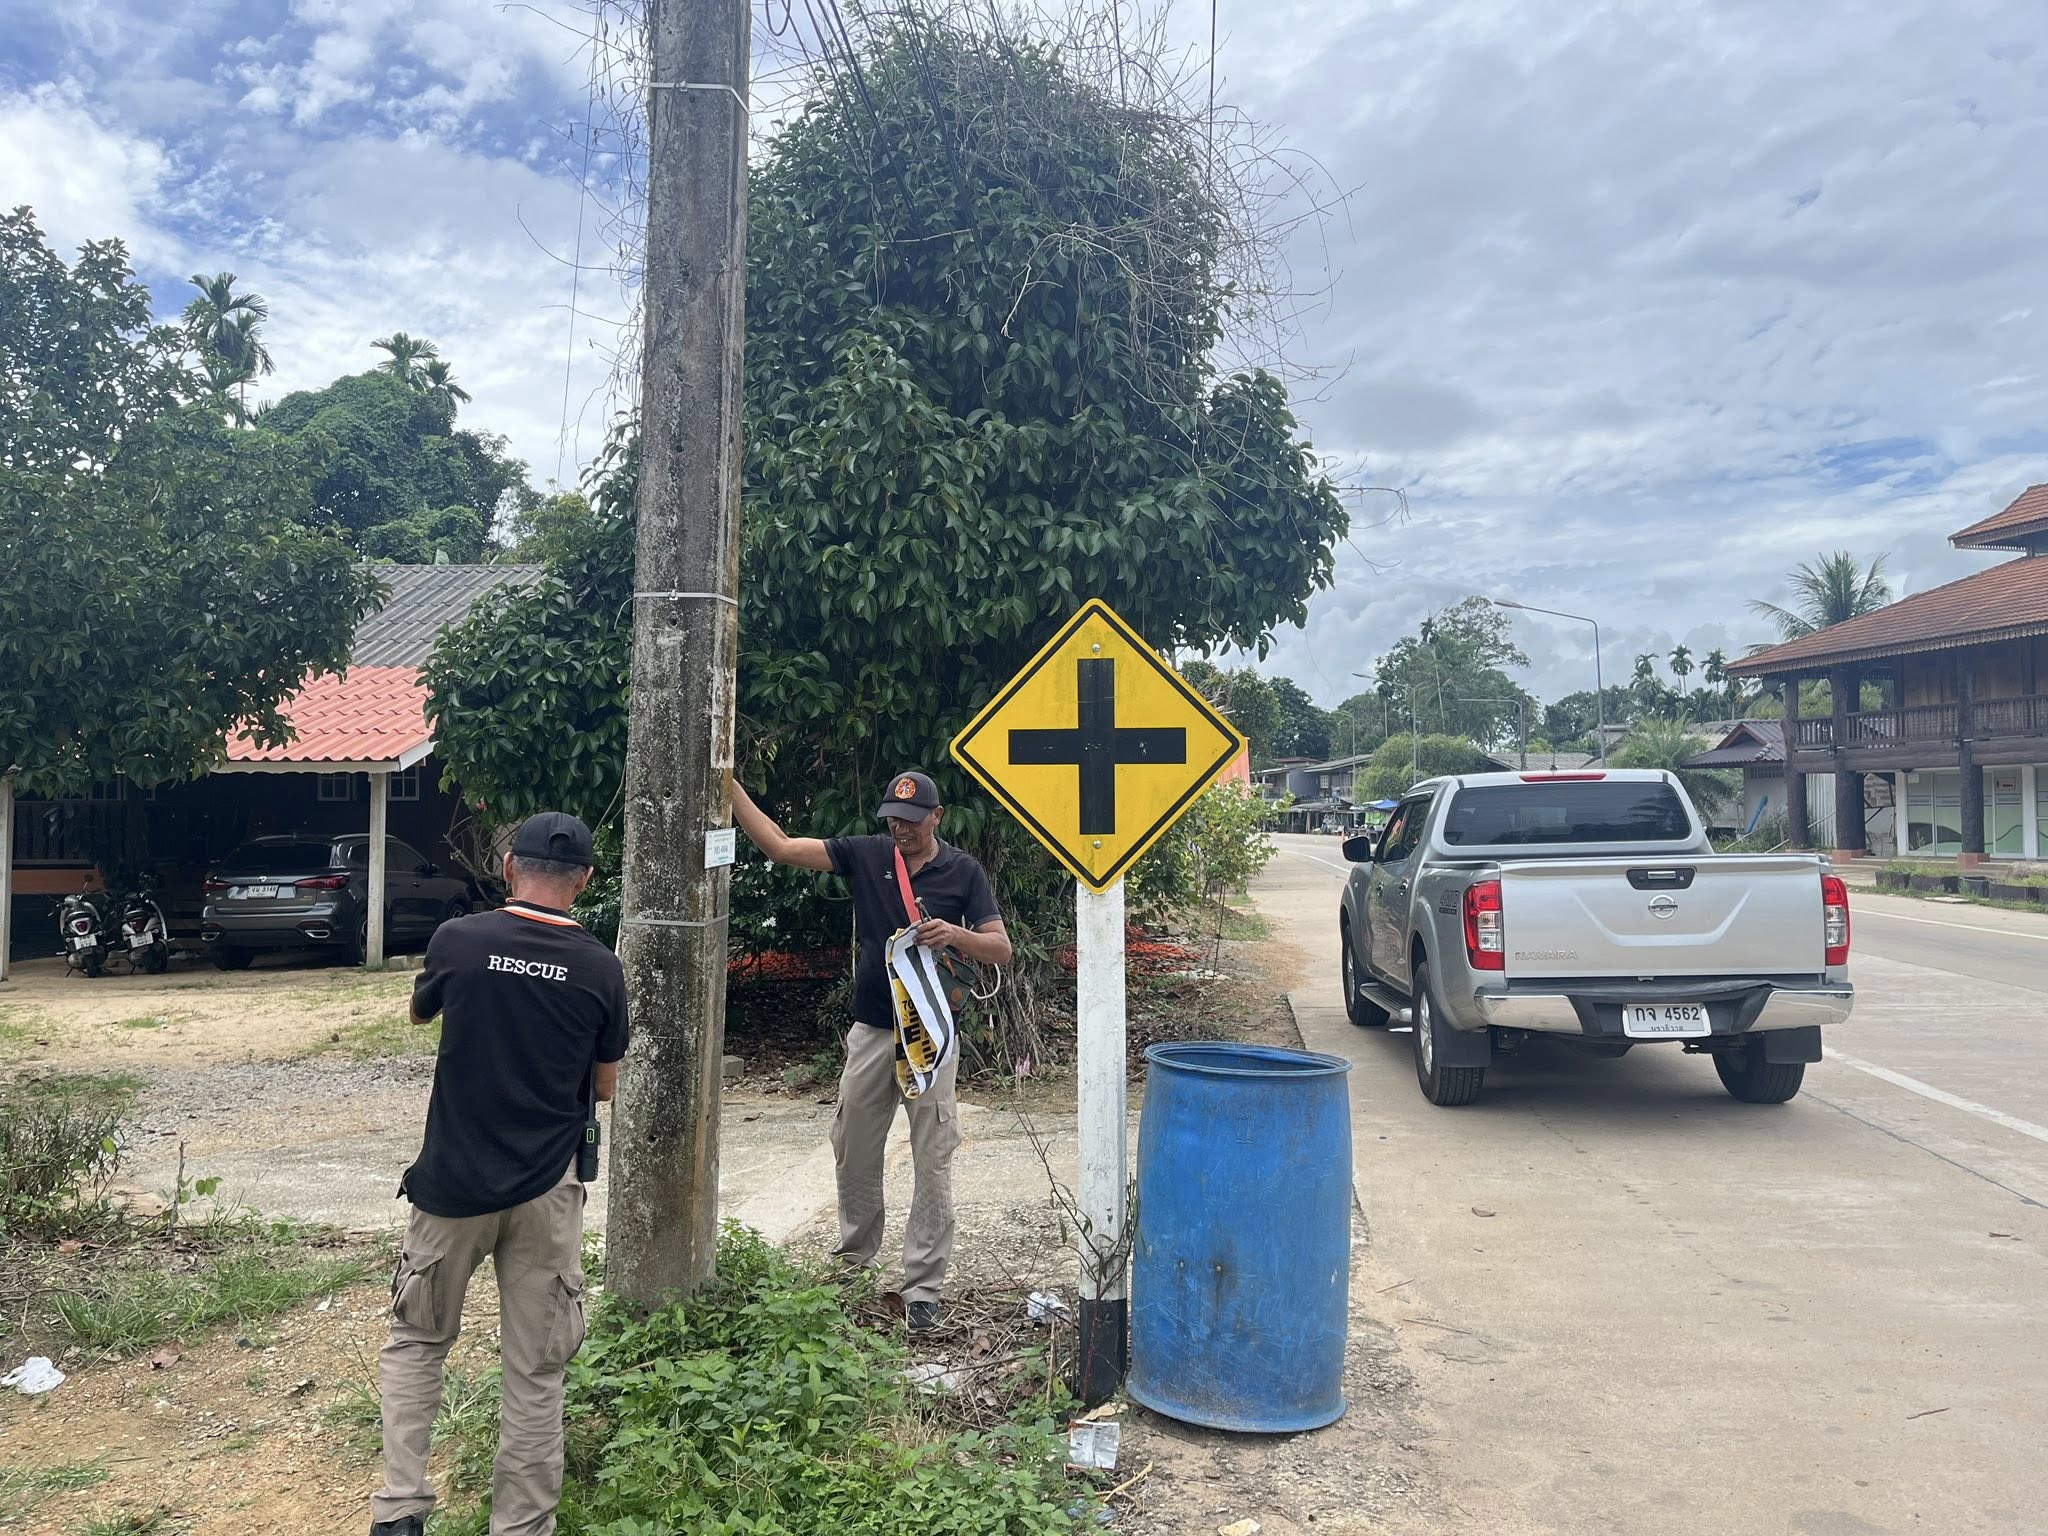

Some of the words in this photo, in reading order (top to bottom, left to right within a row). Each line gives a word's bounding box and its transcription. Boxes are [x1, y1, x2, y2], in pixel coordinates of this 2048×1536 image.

[1515, 951, 1579, 961] NAVARA
[487, 954, 569, 982] RESCUE
[1635, 1007, 1657, 1021] กจ
[1665, 1007, 1701, 1021] 4562
